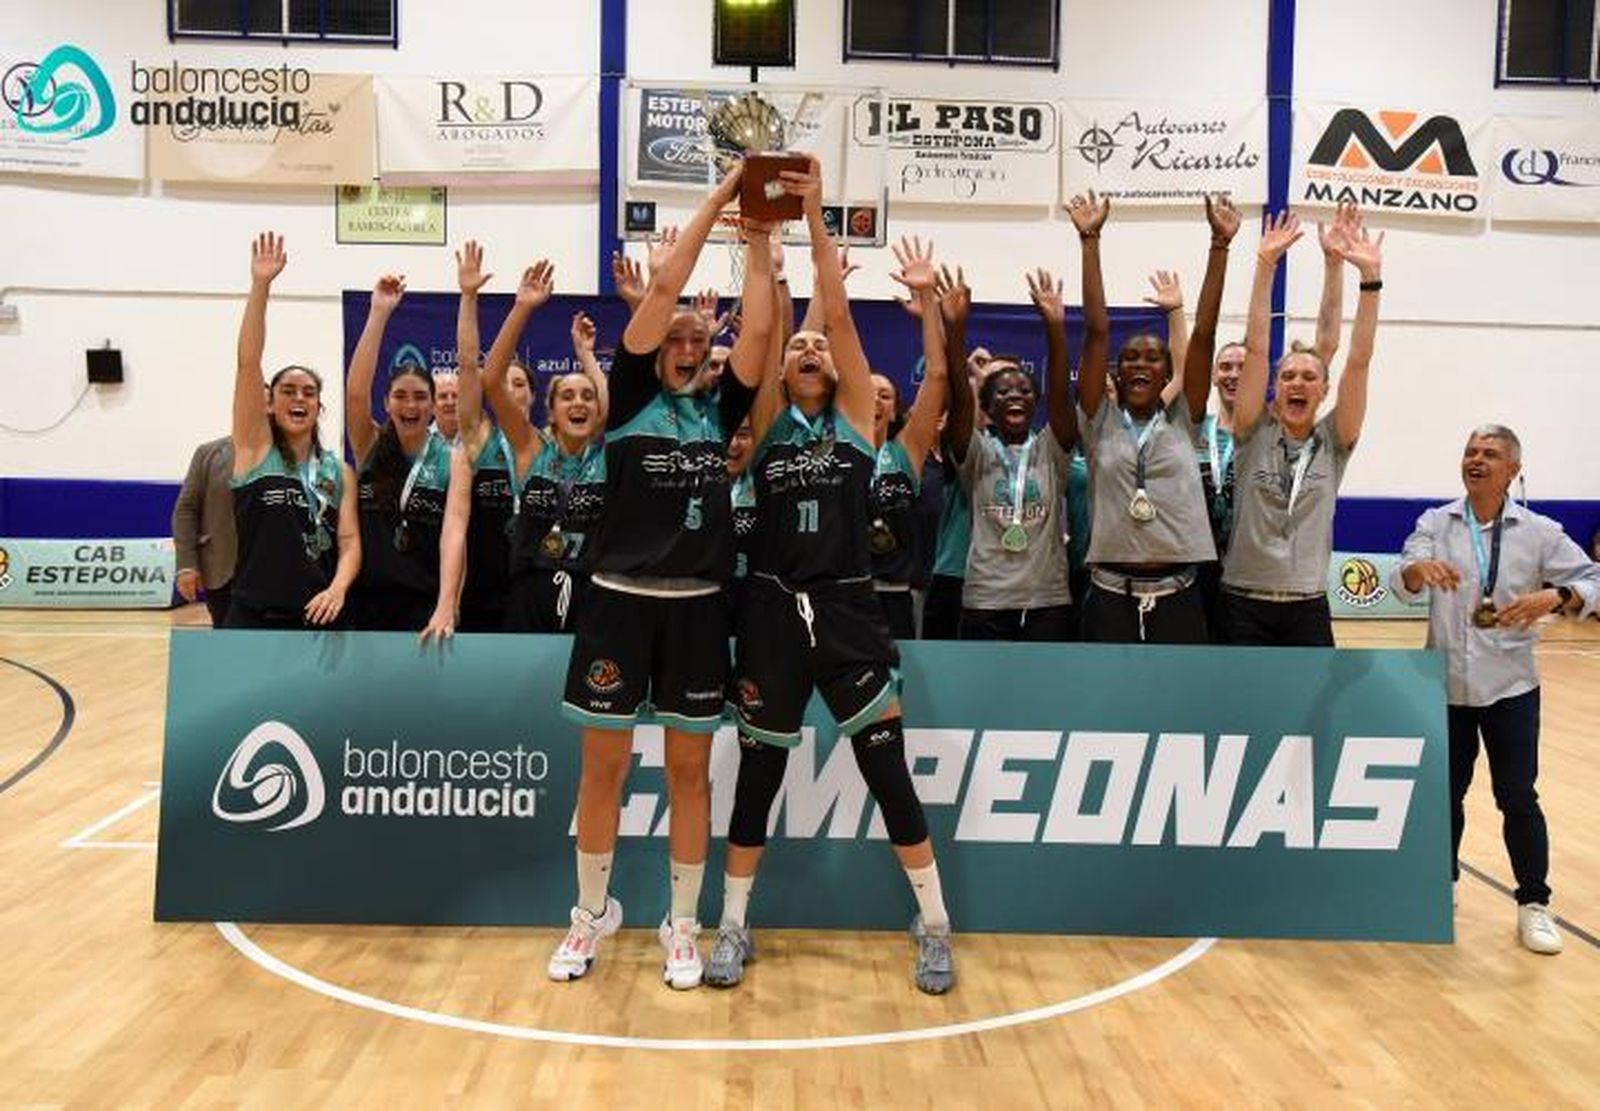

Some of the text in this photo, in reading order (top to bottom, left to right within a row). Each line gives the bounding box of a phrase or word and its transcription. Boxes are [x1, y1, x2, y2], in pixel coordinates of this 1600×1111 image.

[437, 81, 543, 123] R&D
[437, 129, 544, 140] ABOGADOS
[935, 105, 1042, 141] PASO
[1113, 110, 1227, 135] Autocares
[912, 134, 997, 148] ESTEPONA
[1131, 138, 1260, 171] Ricardo
[1304, 182, 1478, 212] MANZANO
[537, 358, 570, 373] azul
[683, 498, 702, 531] 5
[798, 500, 819, 532] 11
[75, 546, 126, 562] CAB
[27, 566, 166, 584] ESTEPONA
[343, 739, 548, 780] baloncesto
